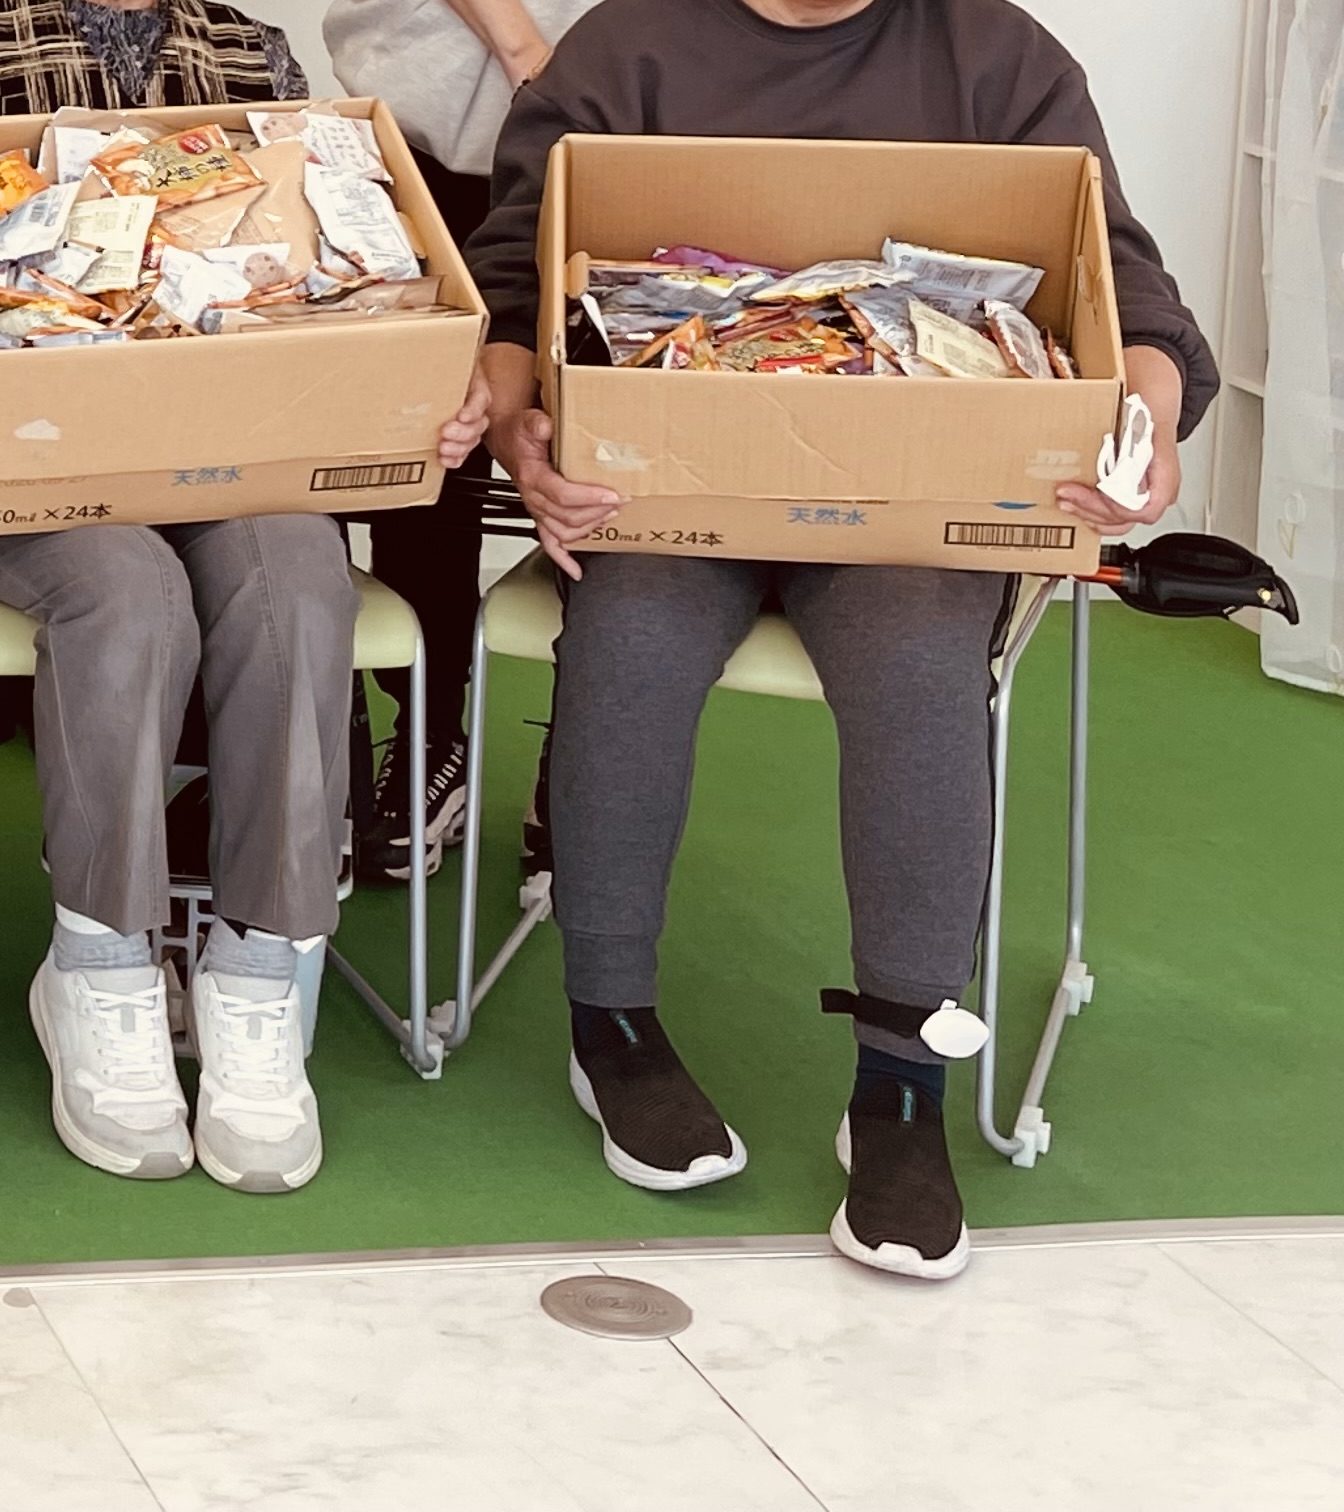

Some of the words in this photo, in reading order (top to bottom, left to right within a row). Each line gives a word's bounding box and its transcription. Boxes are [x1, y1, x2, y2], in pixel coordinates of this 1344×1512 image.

[171, 466, 243, 486] 天然水
[787, 506, 867, 526] 天然水
